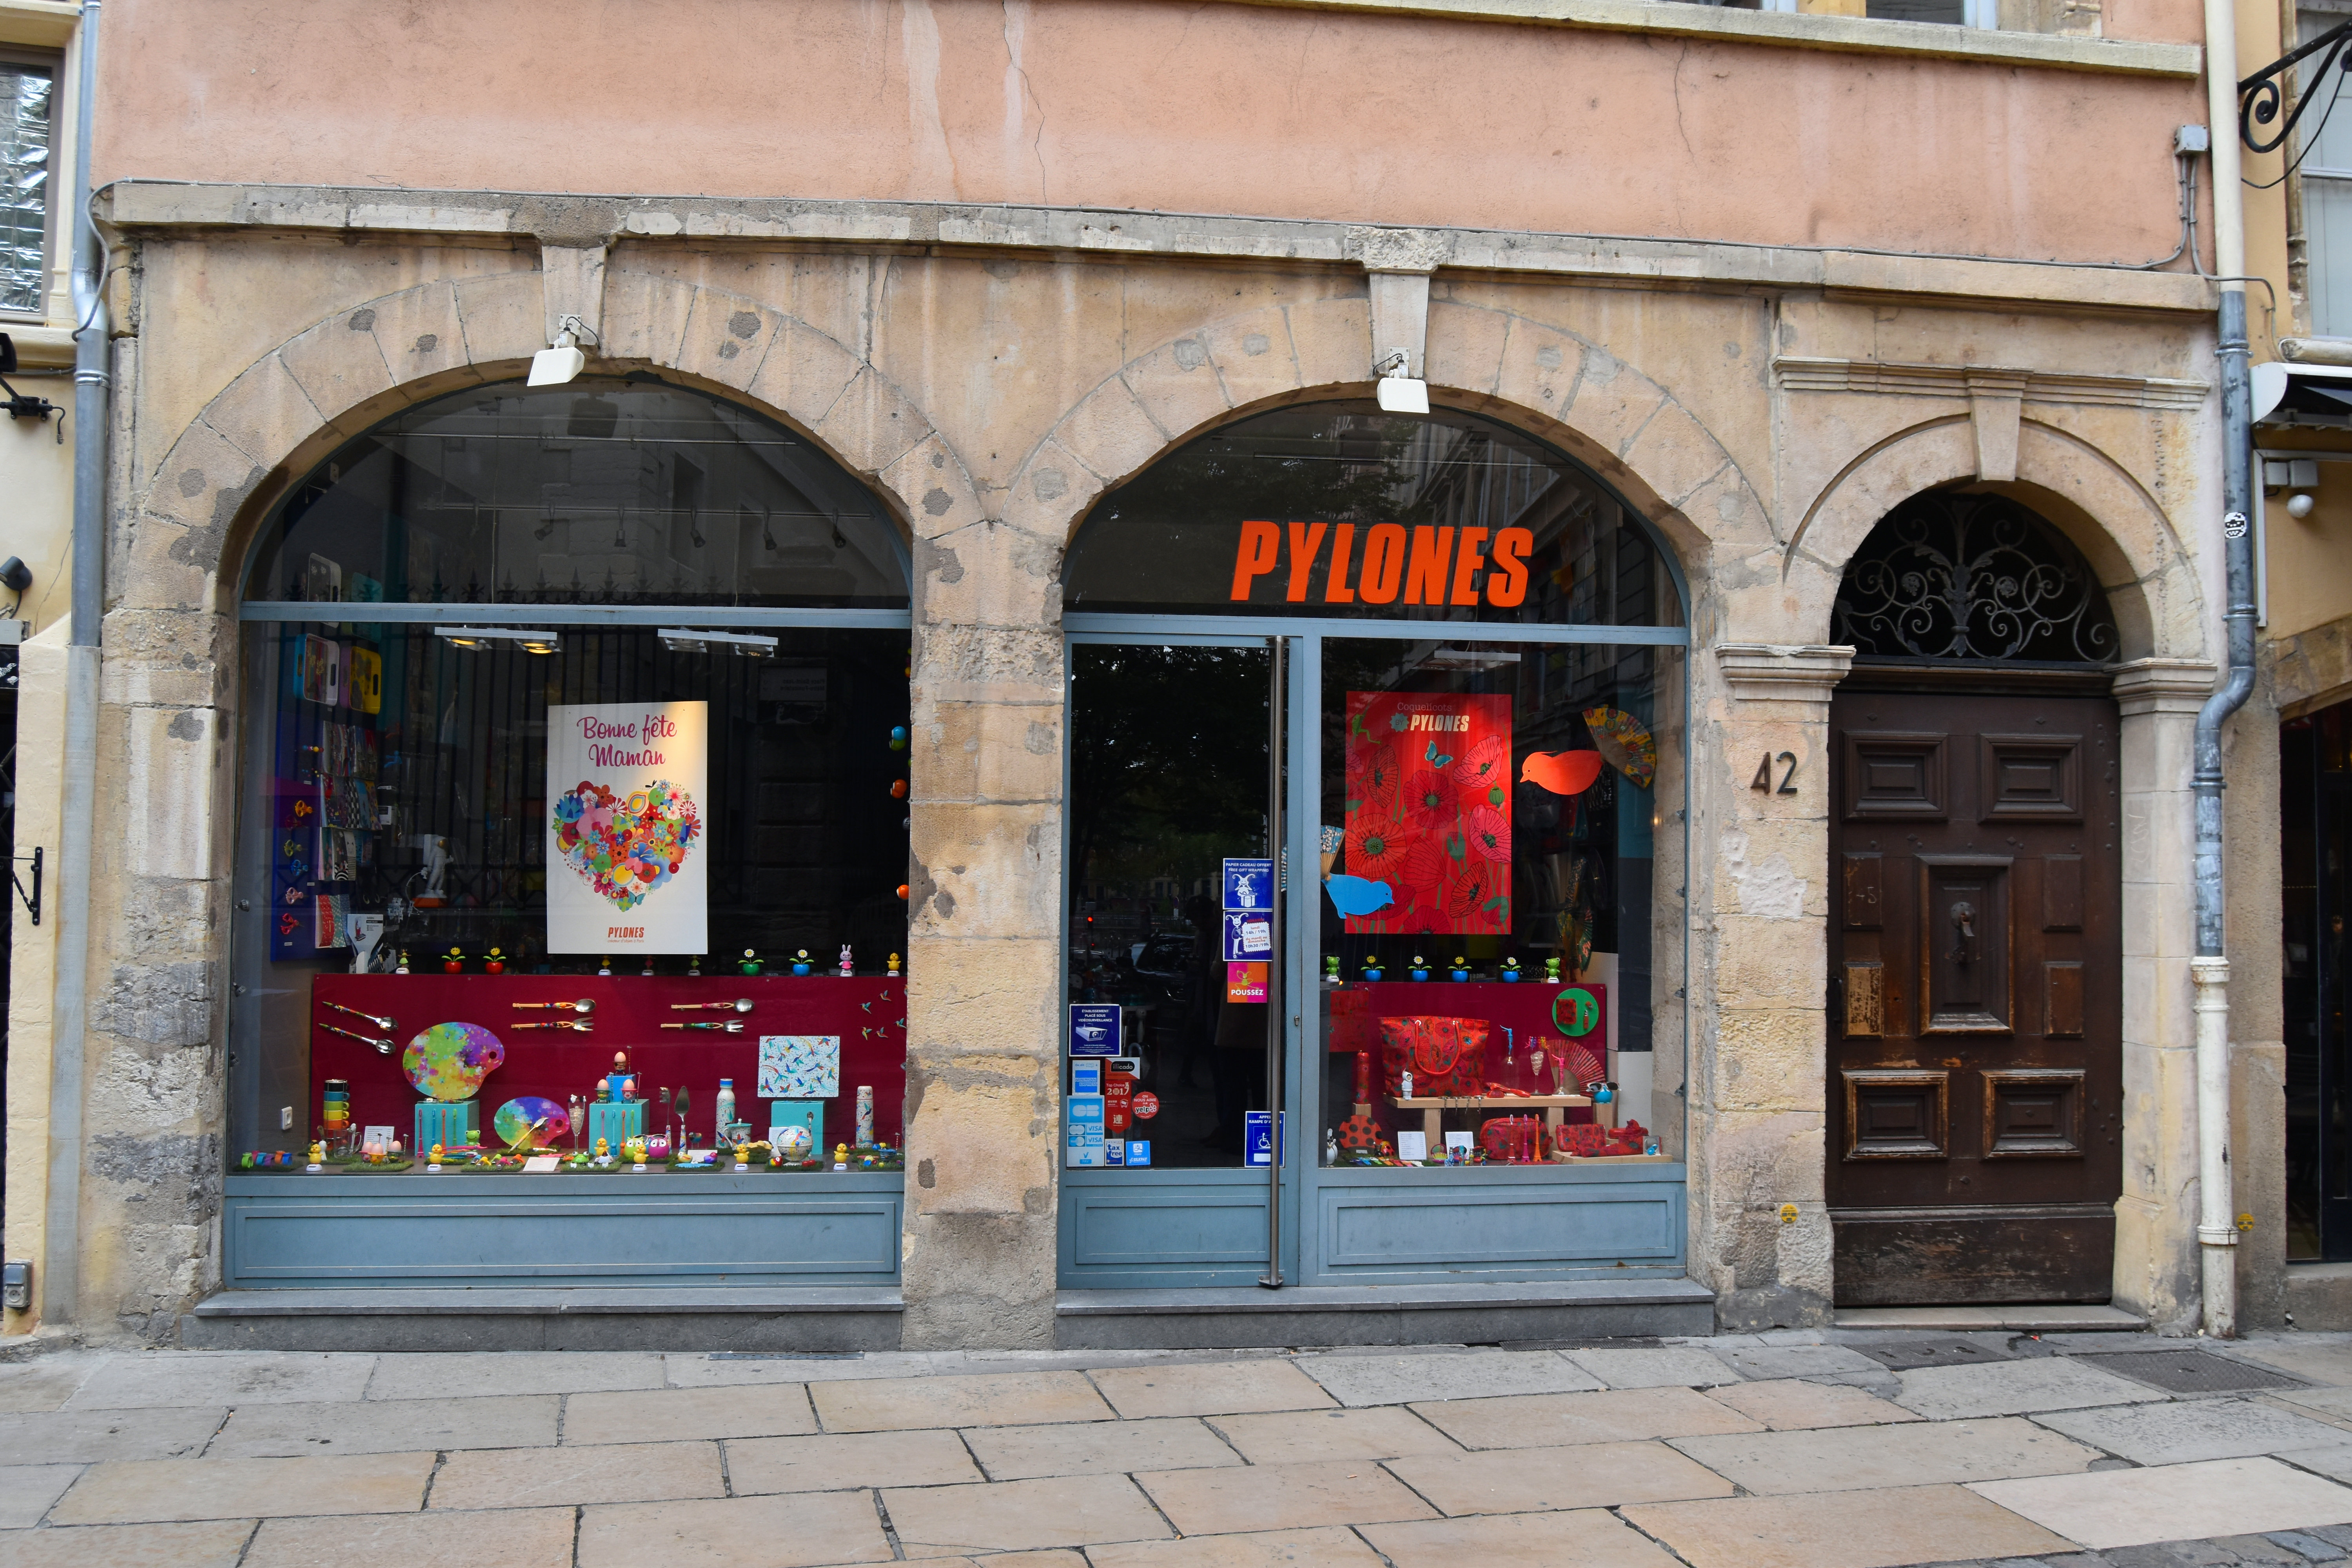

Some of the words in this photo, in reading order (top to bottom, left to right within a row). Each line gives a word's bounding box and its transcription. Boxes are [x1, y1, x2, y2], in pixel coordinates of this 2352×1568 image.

[1230, 521, 1534, 607] PYLONES
[1397, 702, 1452, 711] Coquelicots
[577, 716, 637, 739] Bonne
[642, 714, 677, 746] fête
[1410, 715, 1470, 731] PYLONES
[588, 744, 666, 767] Maman
[1751, 751, 1798, 794] 42
[608, 927, 644, 938] PYLONES
[1107, 1086, 1129, 1095] 2017
[1073, 1105, 1100, 1117] CB
